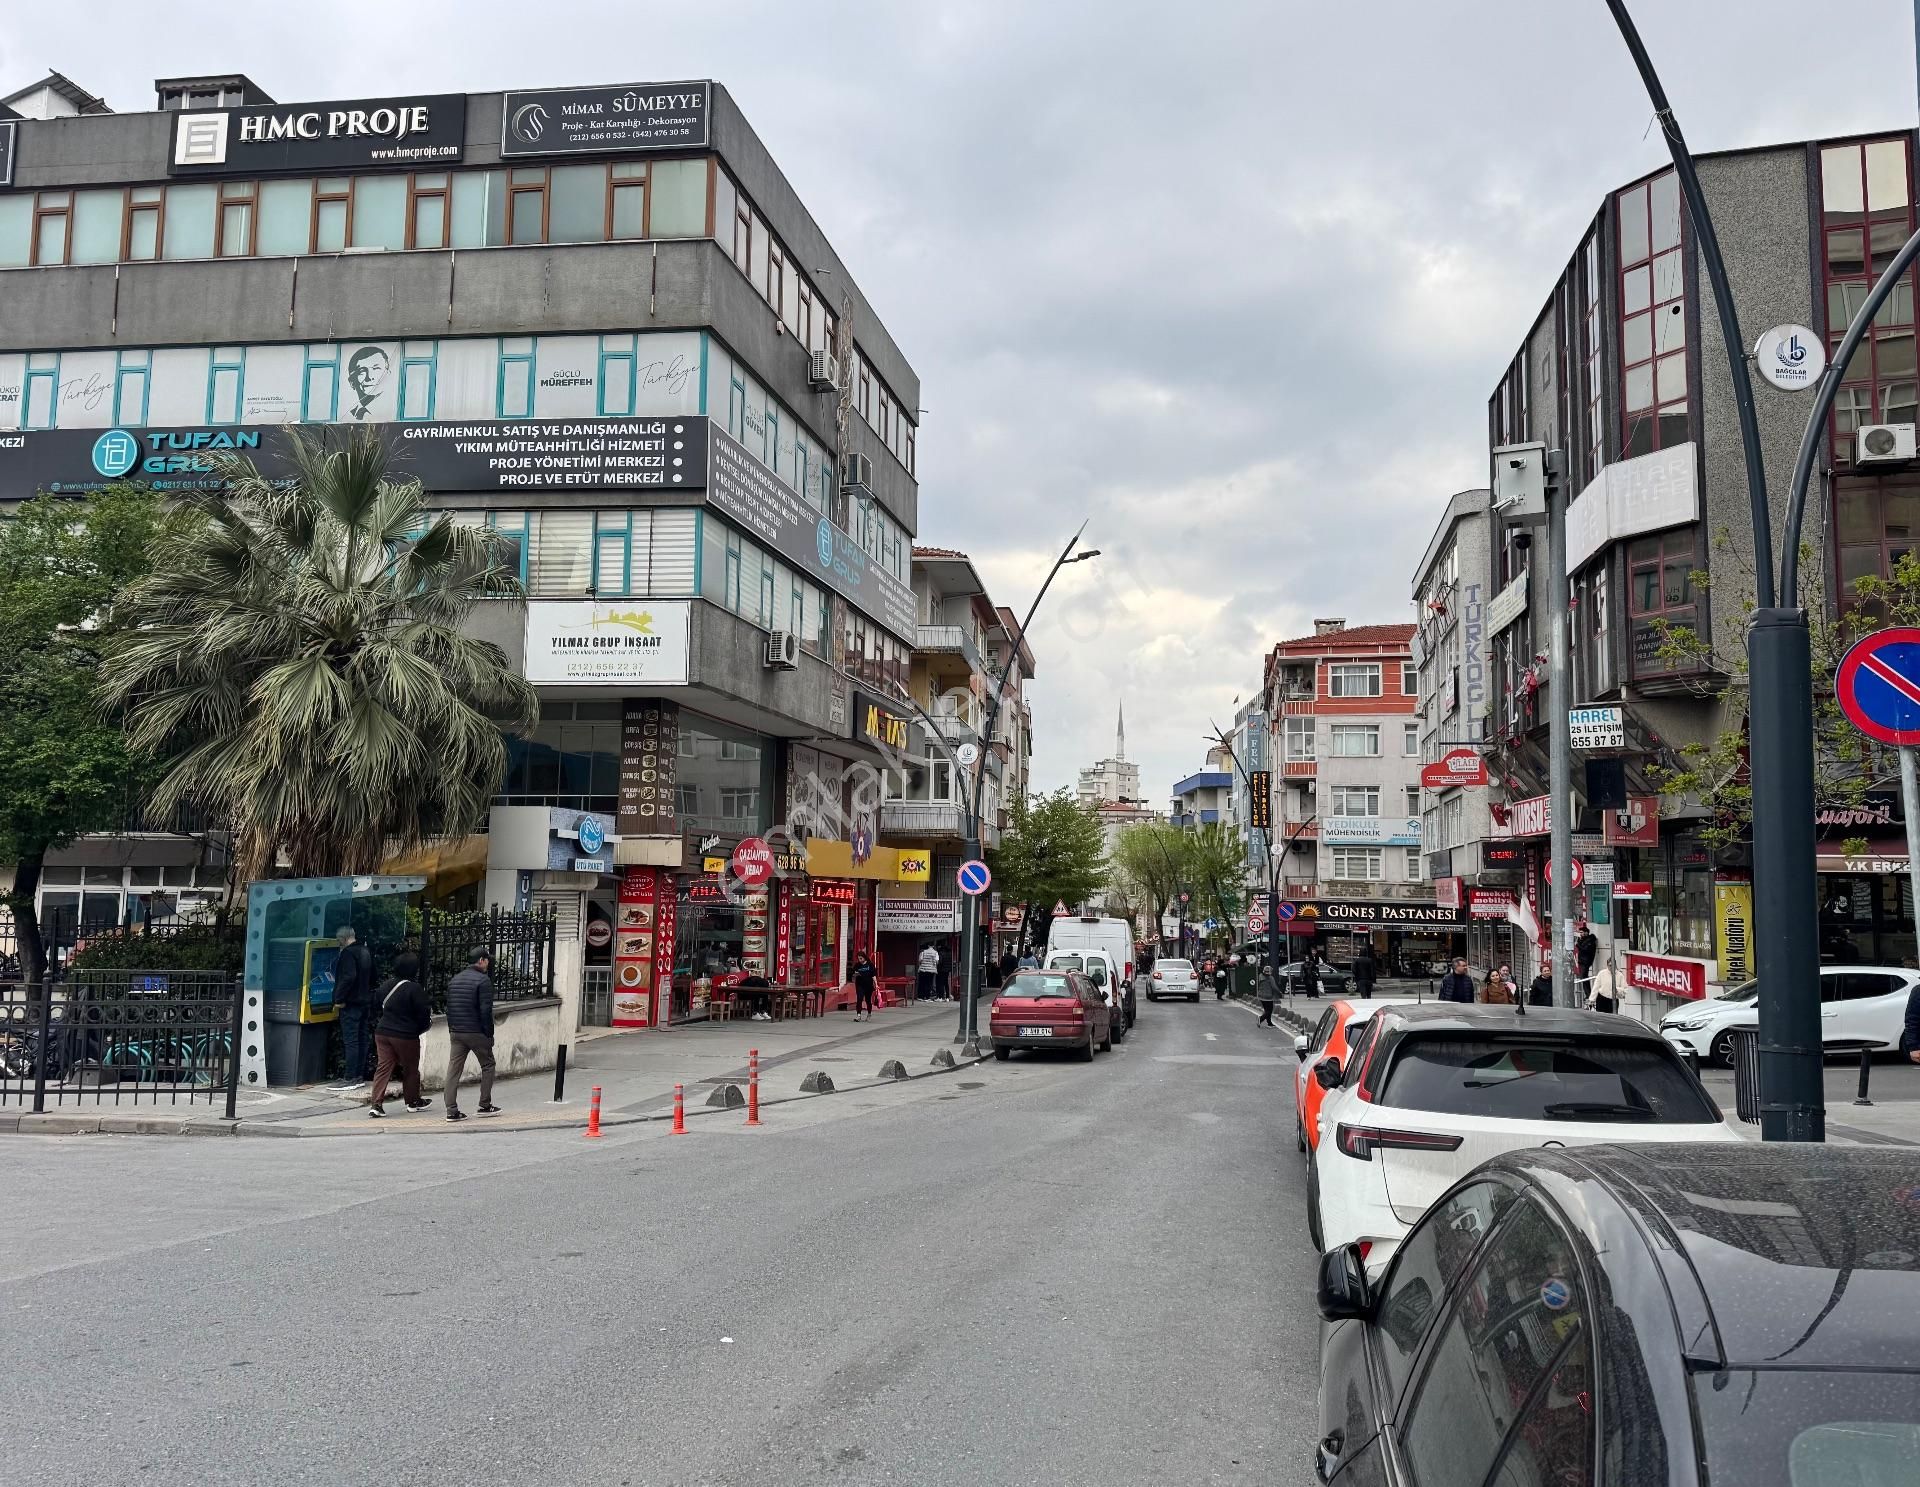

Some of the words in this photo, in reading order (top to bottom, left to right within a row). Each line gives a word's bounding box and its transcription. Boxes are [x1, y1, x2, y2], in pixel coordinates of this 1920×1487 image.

[561, 103, 603, 115] MİMAR
[239, 111, 322, 143] HMC
[327, 105, 429, 141] PROJE
[562, 121, 583, 131] Proje
[590, 120, 604, 130] Kat
[648, 116, 697, 128] Dekorasyon
[569, 131, 588, 142] (212)
[632, 130, 652, 139] (542)
[653, 129, 667, 137] 476
[669, 128, 678, 136] 30
[371, 144, 458, 161] www.hmcproje.com
[553, 369, 581, 379] GÜÇLÜ
[1776, 368, 1806, 376] BAĞCILAR
[540, 377, 593, 388] MÜREFFEH
[403, 426, 500, 439] GAYRİMENKUL
[502, 425, 540, 438] SATIŞ
[543, 425, 559, 436] VE
[563, 422, 666, 436] DANIŞMANLIĞI
[146, 431, 261, 451] TUFAN
[455, 442, 493, 453] YIKIM
[496, 438, 605, 452] MÜTEAHHİTLİĞİ
[608, 438, 665, 451] HİZMETİ
[489, 457, 532, 469] PROJE
[534, 455, 601, 468] YÖNETİMİ
[604, 454, 665, 468] MERKEZİ
[500, 473, 542, 485] PROJE
[545, 473, 562, 484] VE
[565, 471, 600, 484] ETÜT
[603, 471, 664, 483] MERKEZİ
[834, 531, 865, 570] TUFAN
[833, 556, 860, 585] GRUP
[552, 637, 589, 648] YILMAZ
[592, 637, 620, 647] GRUP
[624, 636, 662, 649] İNŞAAT
[567, 663, 593, 671] (212)
[617, 663, 629, 671] 22
[632, 663, 645, 671] 37
[1570, 709, 1617, 724] KAREL
[1584, 723, 1623, 734] İLETİŞİM
[1572, 736, 1591, 748] 655
[1594, 735, 1607, 747] 87
[1610, 734, 1623, 746] 87
[1250, 740, 1258, 766] FEN
[1512, 799, 1544, 836] KURSU
[1816, 804, 1890, 827] uaförü
[1328, 820, 1379, 829] YEDİKULE
[1326, 829, 1380, 837] MÜHENDİSLİK
[577, 862, 587, 870] ÜTÜ
[588, 862, 603, 871] PAKET
[745, 864, 763, 876] KEBAP
[1845, 861, 1868, 872] Y.K
[1872, 861, 1912, 873] ERKE
[885, 902, 911, 910] İSTANBUL
[913, 901, 951, 910] MÜHENDİSLİK
[1327, 904, 1375, 919] GÜNEŞ
[1381, 906, 1457, 921] PASTANESİ
[778, 885, 788, 977] DÜRÜMCÜ
[1724, 917, 1745, 954] Kuaförü
[1641, 963, 1691, 992] PİMAPEN
